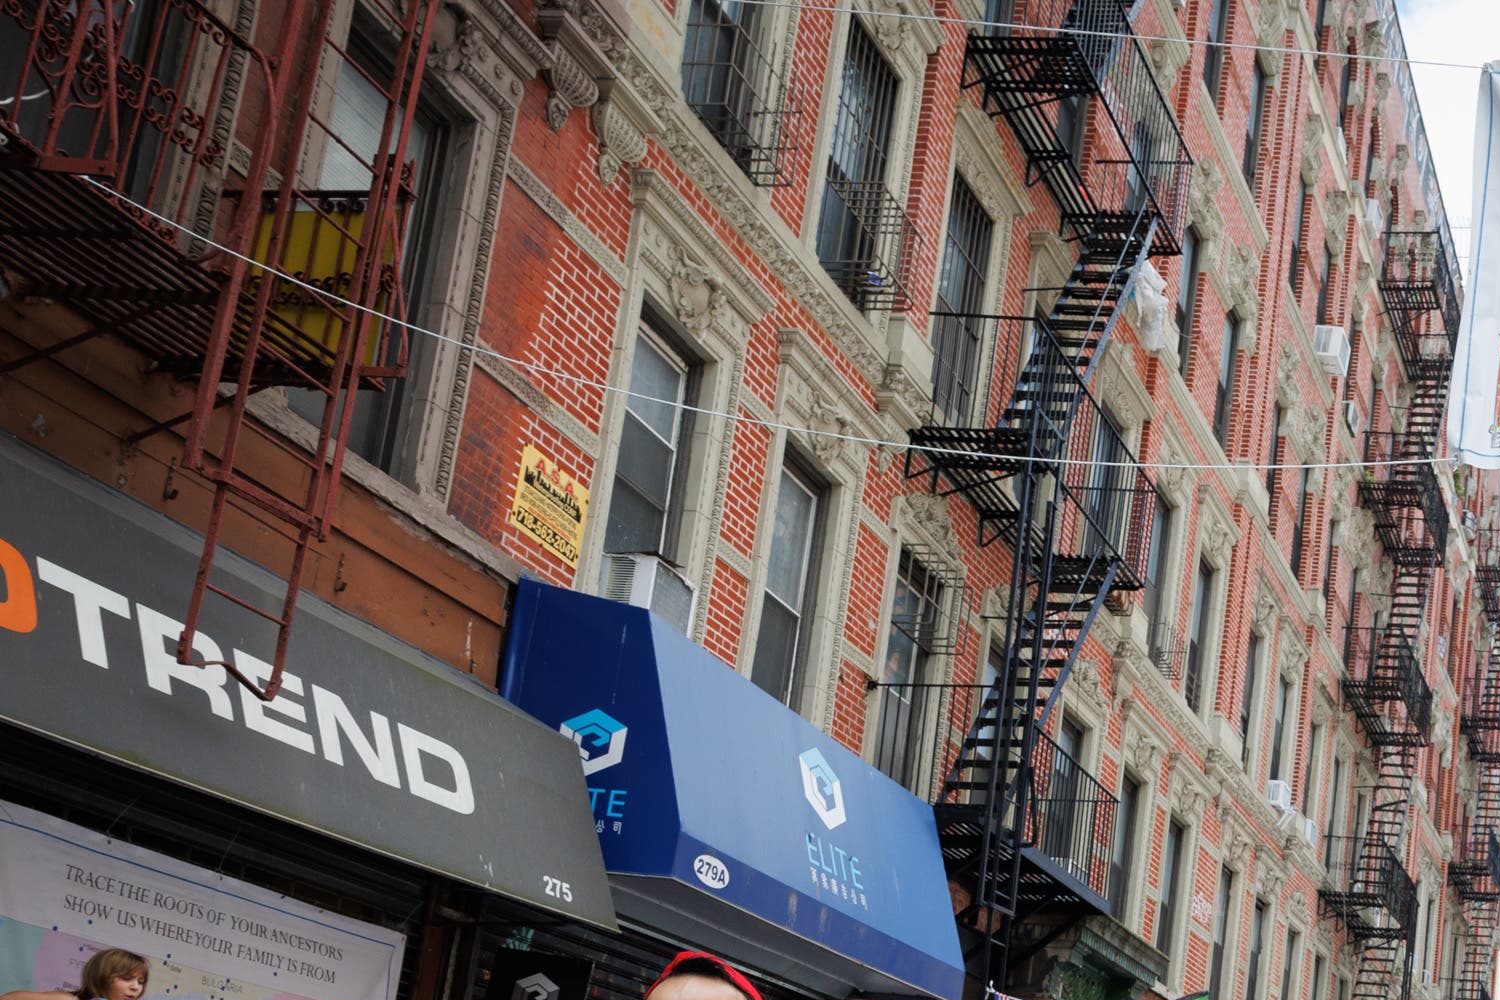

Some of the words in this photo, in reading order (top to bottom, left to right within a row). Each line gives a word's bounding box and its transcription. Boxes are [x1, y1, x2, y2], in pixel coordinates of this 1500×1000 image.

[517, 506, 576, 562] 718-562-2047
[543, 875, 573, 903] 275
[696, 859, 727, 886] 279A
[805, 832, 864, 890] ELITE
[63, 894, 113, 921] SHOW
[117, 909, 138, 929] US
[139, 915, 194, 944] WHERE
[193, 930, 233, 957] YOUR
[236, 944, 285, 971] FAMILY
[287, 958, 298, 973] IS
[299, 961, 337, 984] FROM
[64, 863, 117, 894] TRACE
[117, 880, 150, 904] THE
[152, 890, 204, 919] ROOTS
[206, 908, 226, 927] OF
[229, 915, 273, 940] YOUR
[271, 930, 344, 962] ANCESTORS
